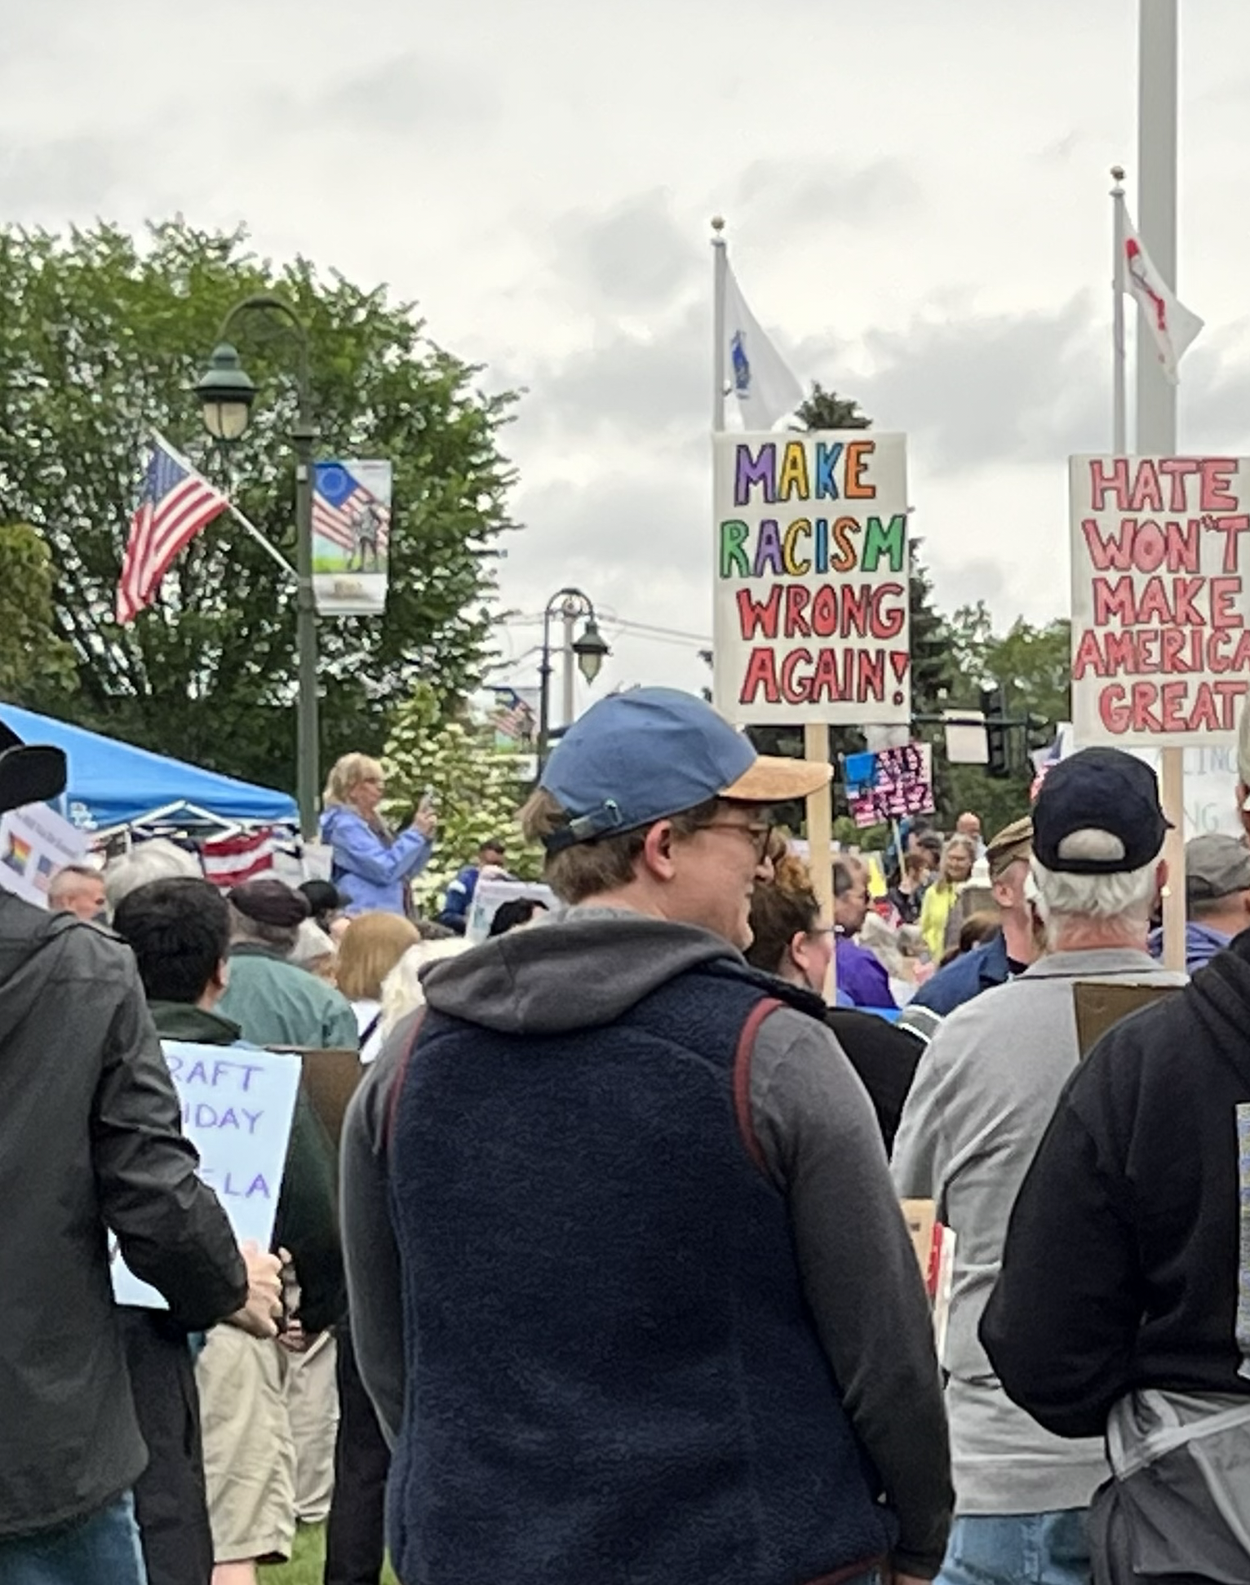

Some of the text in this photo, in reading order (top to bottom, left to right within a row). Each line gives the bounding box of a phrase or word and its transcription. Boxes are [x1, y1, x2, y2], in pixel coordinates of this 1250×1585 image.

[734, 441, 875, 506] MAKE
[1089, 459, 1238, 512] HATE
[719, 514, 906, 578] RACISM
[1081, 514, 1250, 574] WON'T
[736, 583, 905, 640] WRONG
[1092, 576, 1244, 628] MAKE
[740, 647, 910, 705] AGAIN!
[1098, 681, 1248, 734] GREAT
[224, 1173, 270, 1198] LA
